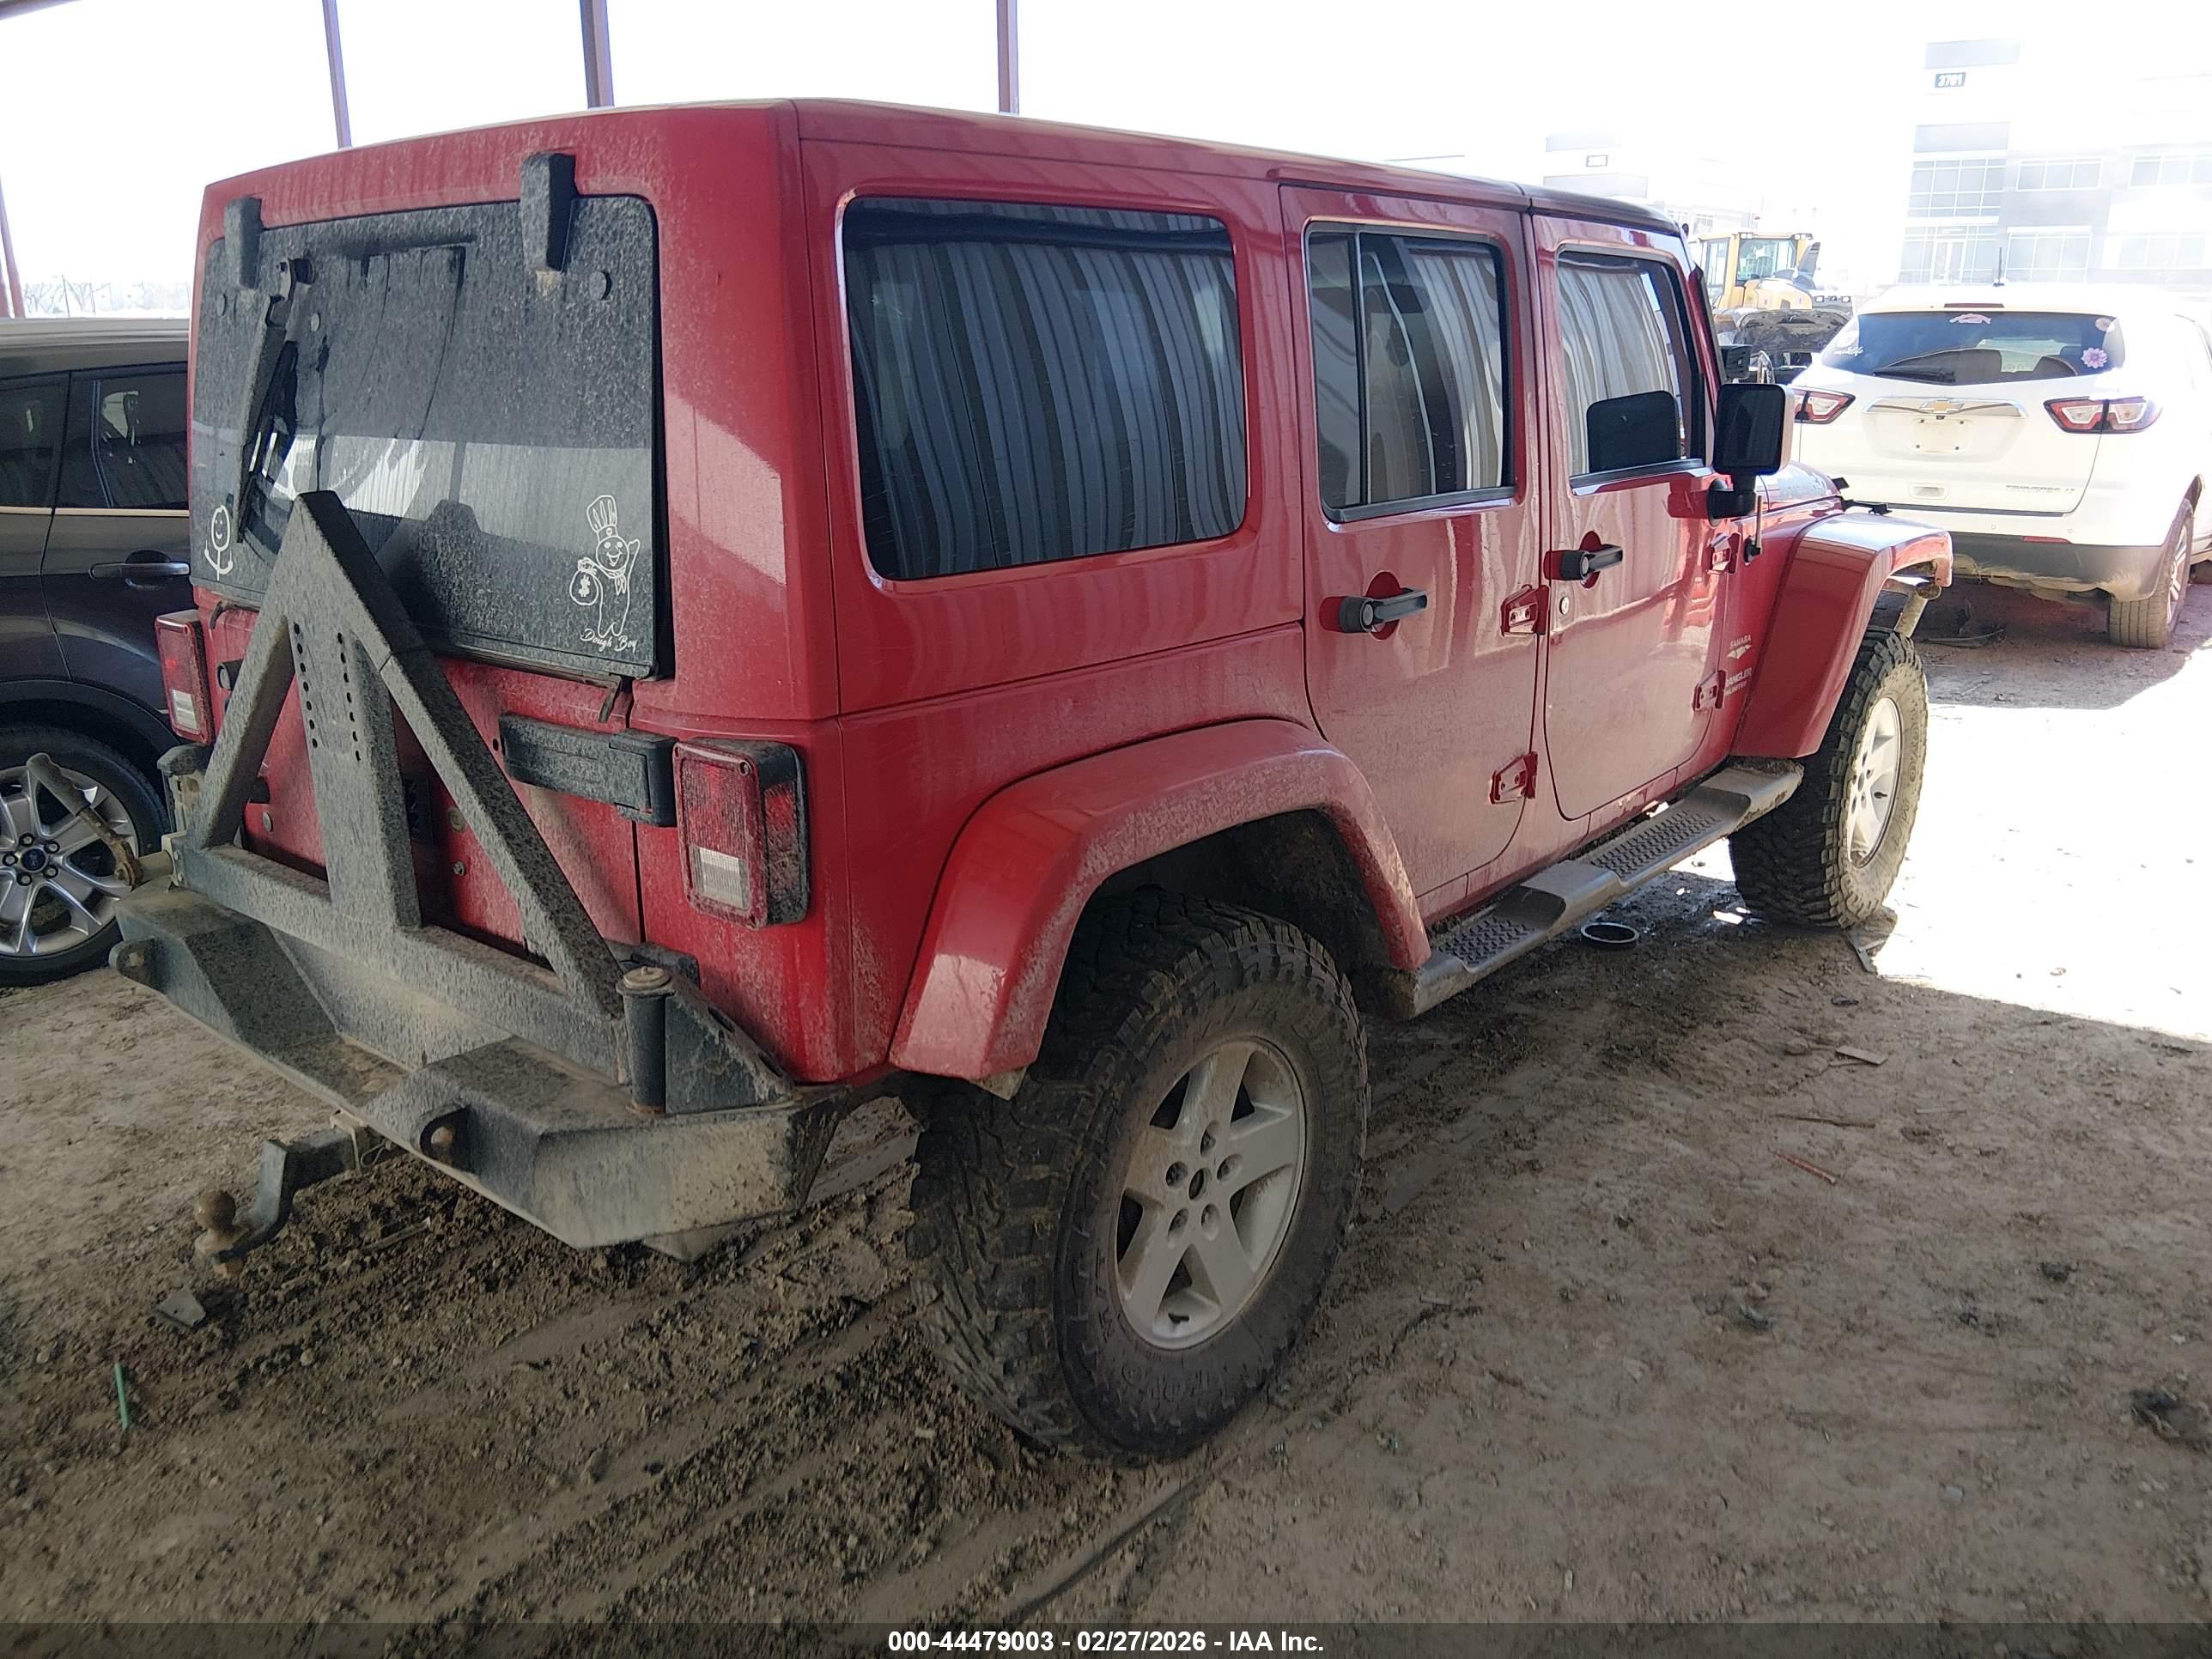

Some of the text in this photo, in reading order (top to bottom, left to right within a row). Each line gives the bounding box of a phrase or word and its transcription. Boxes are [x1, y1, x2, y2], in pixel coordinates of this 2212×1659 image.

[1937, 73, 1963, 88] 3701
[580, 628, 638, 653] Dough Boy
[1729, 634, 1752, 650] SAHARA
